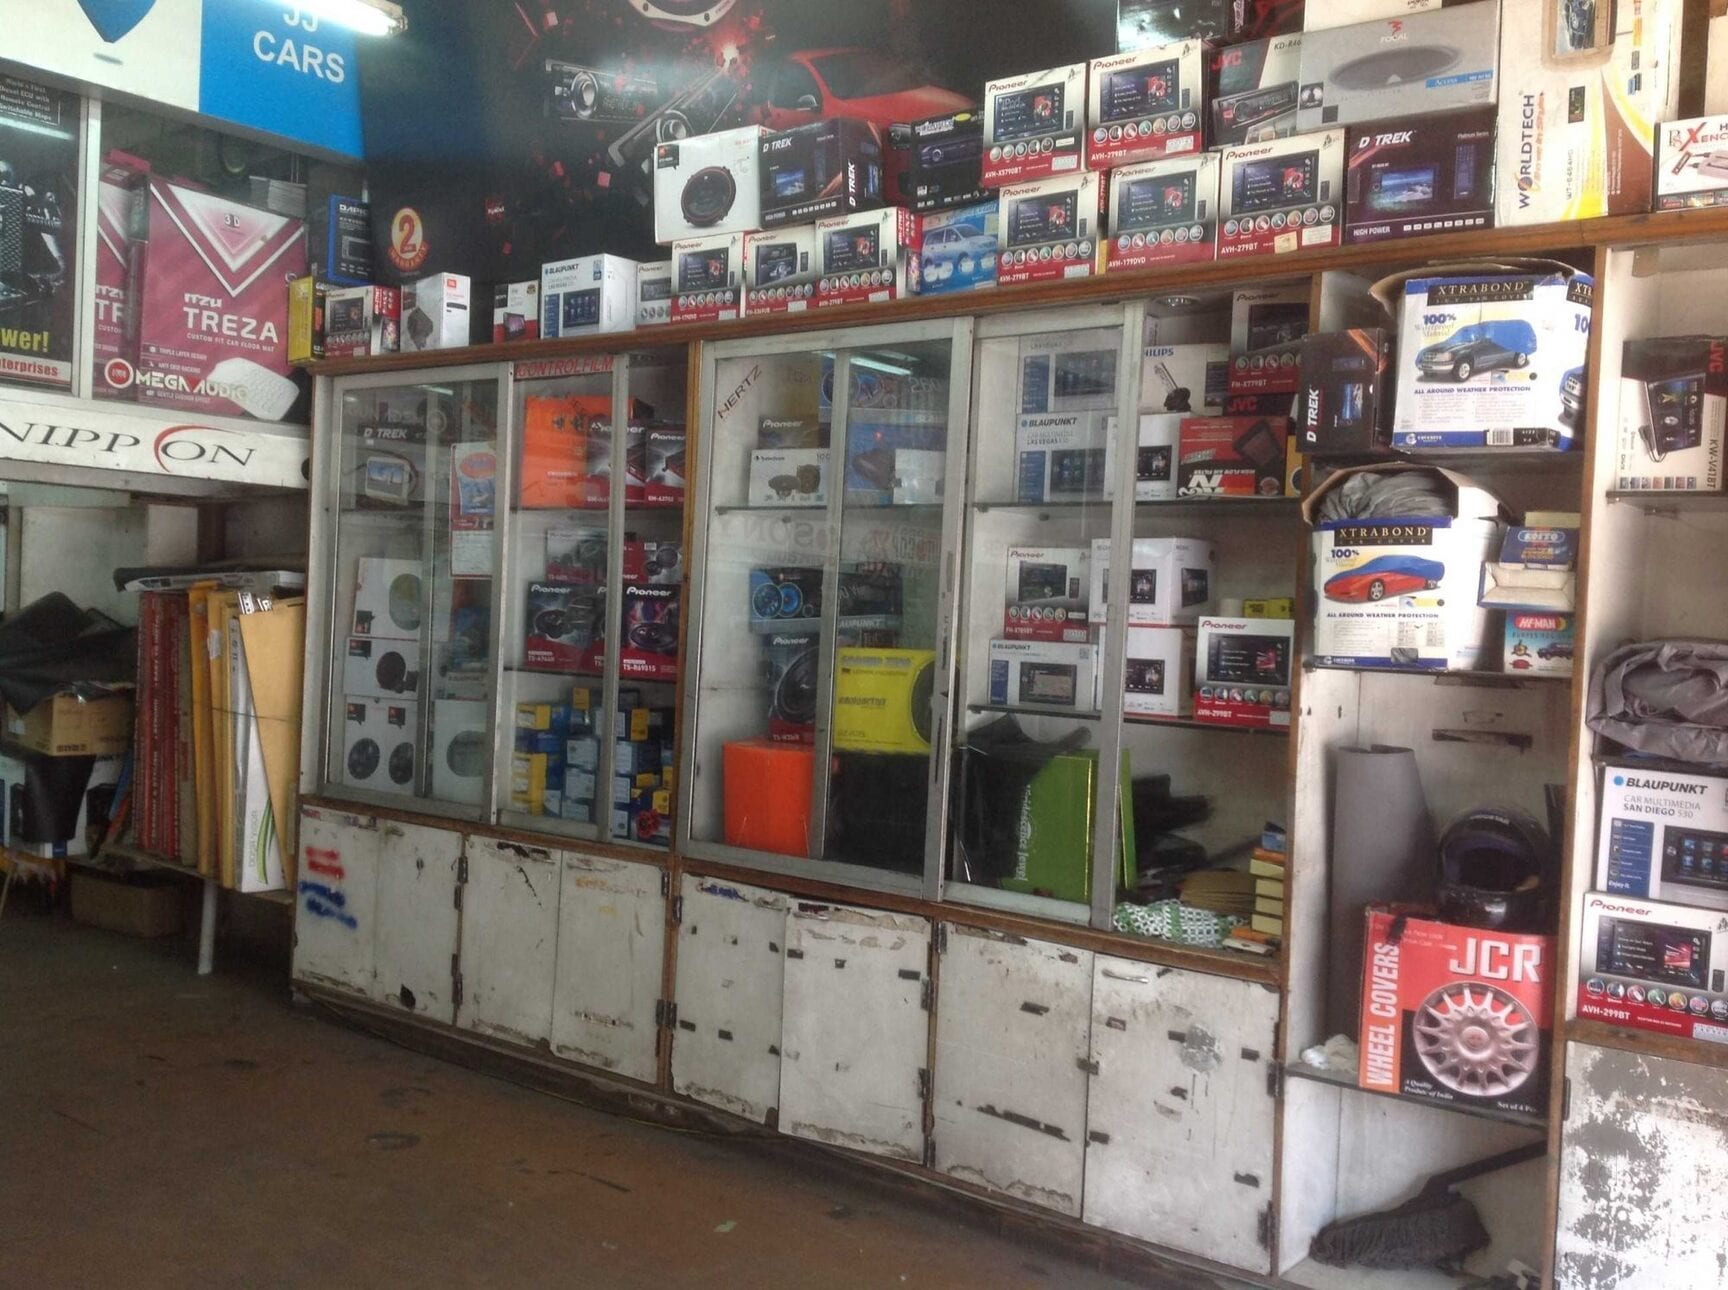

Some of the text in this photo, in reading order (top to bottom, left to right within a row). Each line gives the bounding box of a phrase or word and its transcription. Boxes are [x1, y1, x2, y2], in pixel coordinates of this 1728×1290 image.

[253, 31, 346, 83] CARS
[1093, 56, 1138, 70] Pioneer
[1211, 51, 1243, 69] JVC
[988, 79, 1028, 93] Pioneer
[771, 137, 793, 150] TREK
[1359, 130, 1413, 149] D TREK
[1226, 146, 1274, 160] Pioneer
[1518, 94, 1535, 209] WORLDTECH
[847, 159, 857, 195] TREK
[1113, 166, 1157, 179] Pioneer
[1002, 186, 1042, 198] Pioneer
[818, 219, 850, 230] Pioneer
[1353, 225, 1391, 236] HIGH POWER
[400, 214, 417, 254] 2
[750, 234, 778, 242] Pioneer
[675, 242, 702, 250] Pioneer
[1221, 243, 1258, 254] AVH-279BT
[549, 263, 580, 275] BLAUPUNKT
[1438, 282, 1525, 296] XTRABOND
[1237, 292, 1280, 301] Pioneer
[183, 307, 279, 343] TREZA
[1423, 312, 1457, 326] 100%
[187, 332, 276, 353] CUSTOM FIT CAR FLOOR MAT
[1709, 339, 1726, 373] JVC
[0, 358, 58, 377] terprises
[717, 365, 763, 420] HERTZ
[1228, 396, 1257, 412] JVC
[1306, 388, 1320, 427] TREK
[762, 419, 804, 429] Pioneer
[1029, 417, 1078, 428] BLAUPUNKT
[377, 428, 408, 439] TREK
[650, 432, 686, 440] Pioneer
[0, 421, 257, 467] NIPPON
[1339, 526, 1427, 538] XTRABOND
[1010, 550, 1045, 558] Pioneer
[1331, 549, 1360, 558] 100%
[531, 584, 571, 594] Pioneer
[626, 586, 672, 597] Pioneer
[1201, 619, 1249, 630] Pioneer
[773, 636, 809, 645] Pioneer
[1626, 777, 1708, 796] BLAUPUNKT
[1623, 794, 1701, 811] CAR MULTIMEDIA
[1623, 803, 1694, 819] SAN DIEGO 530
[1590, 899, 1652, 917] Pioneer
[1449, 937, 1542, 983] JCR
[1366, 942, 1400, 1085] WHEEL COVERS
[1582, 1003, 1631, 1020] AVH-299BT
[1411, 1079, 1432, 1090] Quality
[1436, 1090, 1453, 1099] India
[1497, 1101, 1508, 1109] Set
[1509, 1102, 1517, 1111] of
